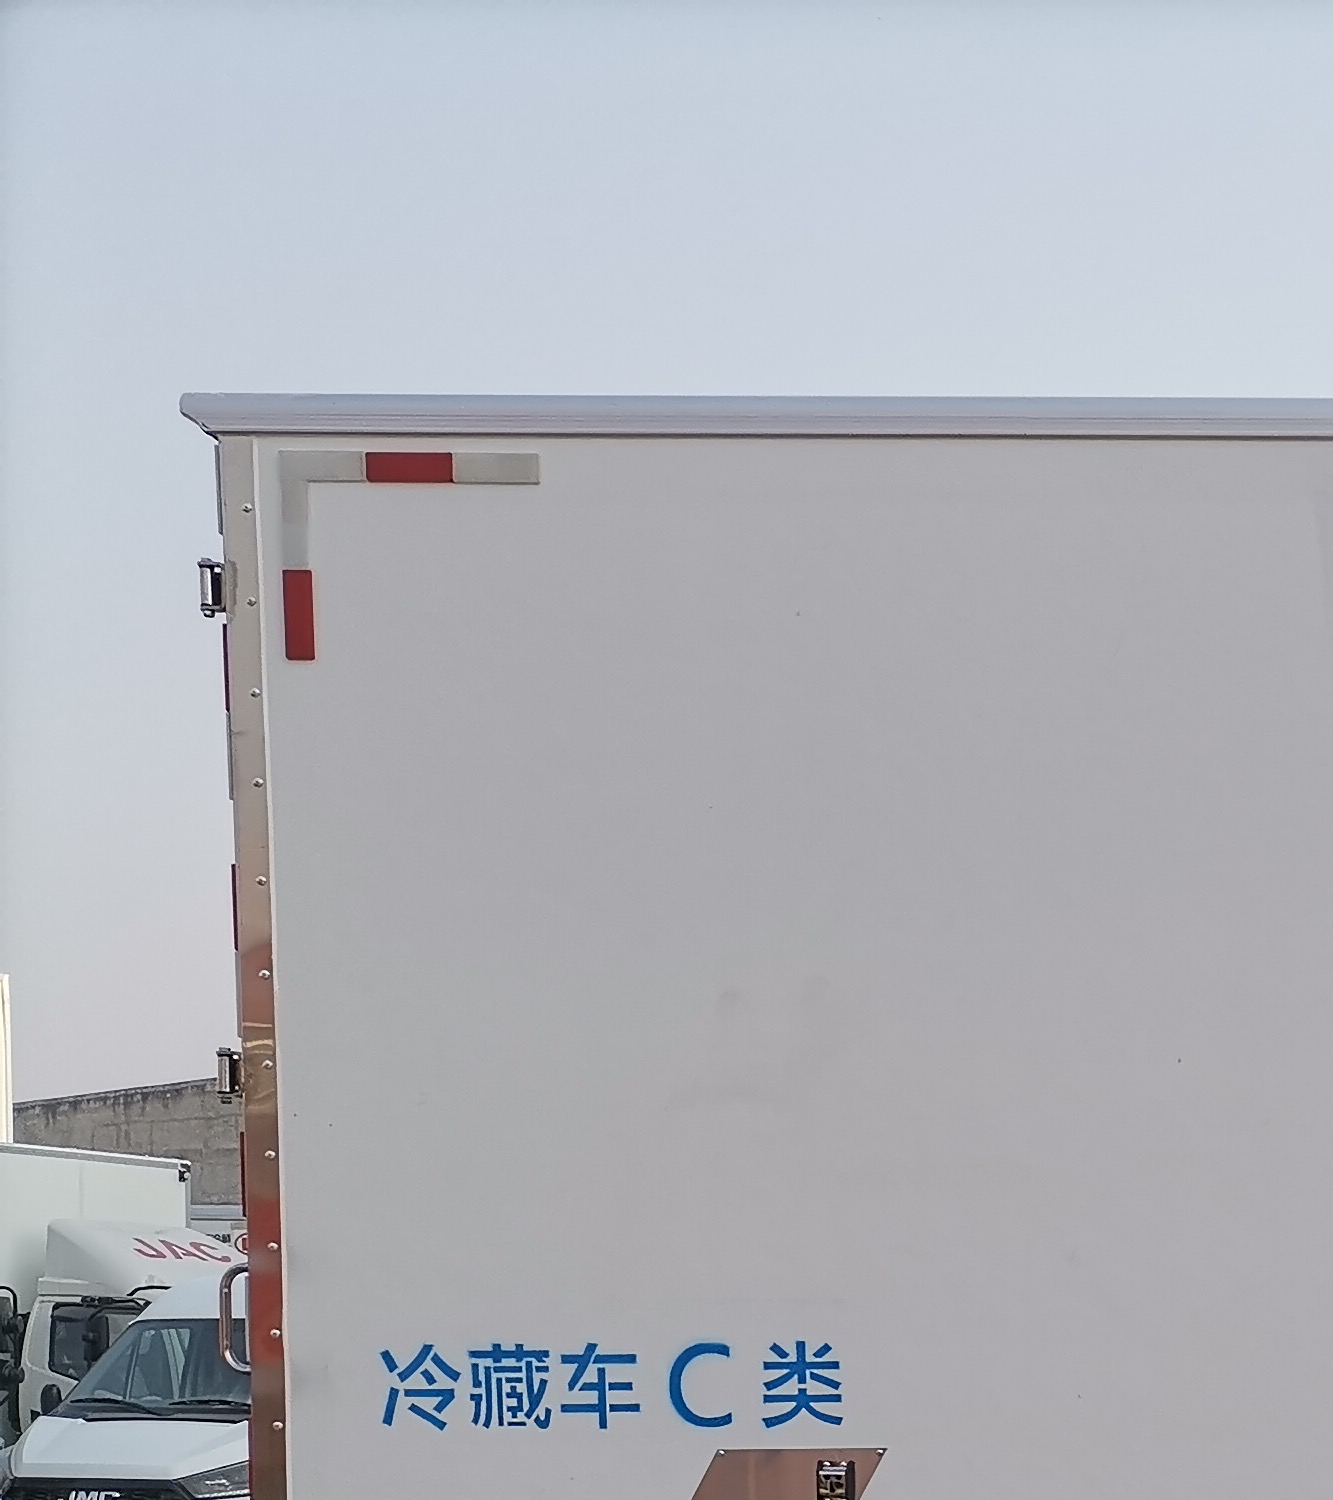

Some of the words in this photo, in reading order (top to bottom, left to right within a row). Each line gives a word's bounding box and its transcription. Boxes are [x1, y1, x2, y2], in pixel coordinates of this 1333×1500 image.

[132, 1236, 232, 1262] JAC
[380, 1342, 641, 1431] 冷藏车
[668, 1342, 734, 1428] C
[761, 1340, 845, 1429] 类
